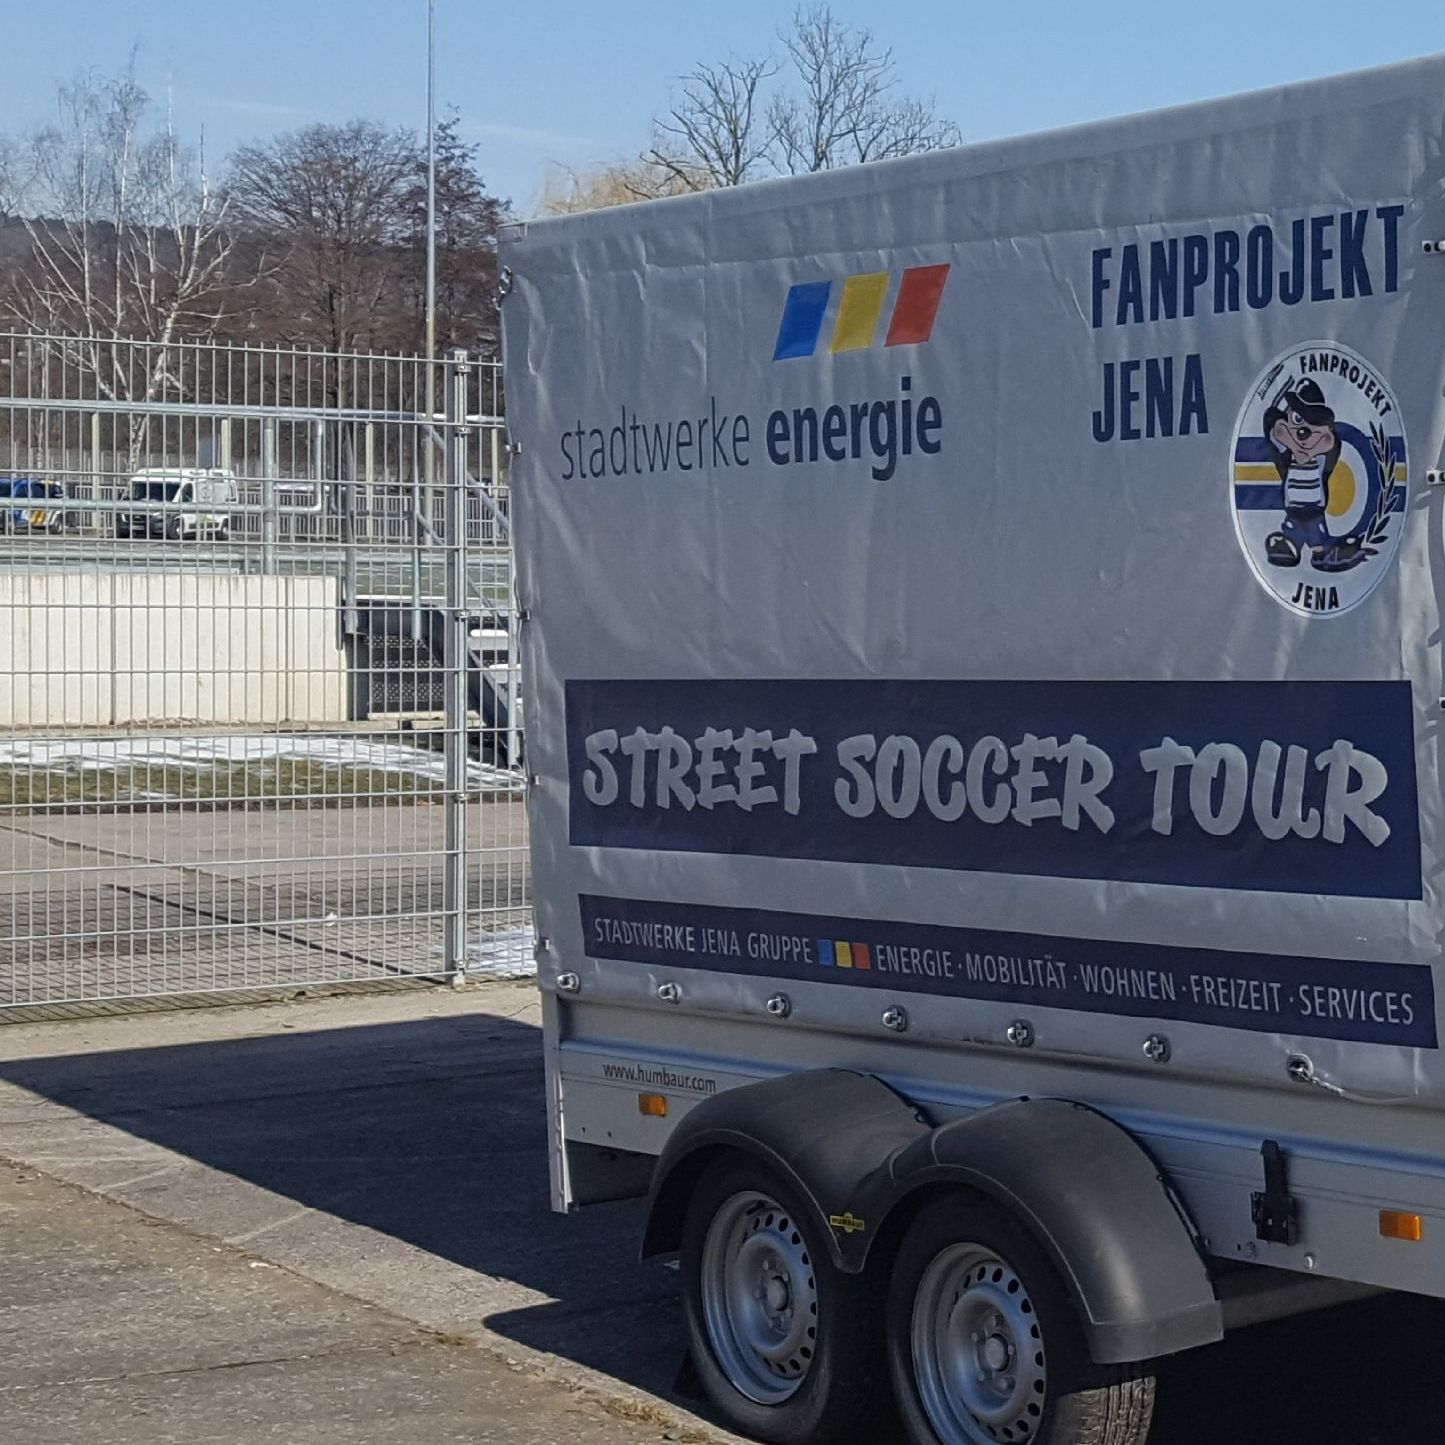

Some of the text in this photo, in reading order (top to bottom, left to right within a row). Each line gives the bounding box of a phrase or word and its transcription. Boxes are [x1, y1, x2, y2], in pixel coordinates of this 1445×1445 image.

[1091, 205, 1404, 328] FANPROJEKT
[560, 376, 942, 481] stadtwerke energie
[1092, 353, 1209, 442] JENA
[1299, 352, 1393, 418] FANPROJEKT
[1291, 583, 1340, 610] JENA
[583, 726, 1391, 848] STREET SOCCER TOUR
[595, 917, 1414, 1026] STADTWERKE JENA GRUPPE ENERGIE MOBILITÄT WOHNEN FREIZEIT SERVICES
[602, 1063, 716, 1093] www.humbaur.com
